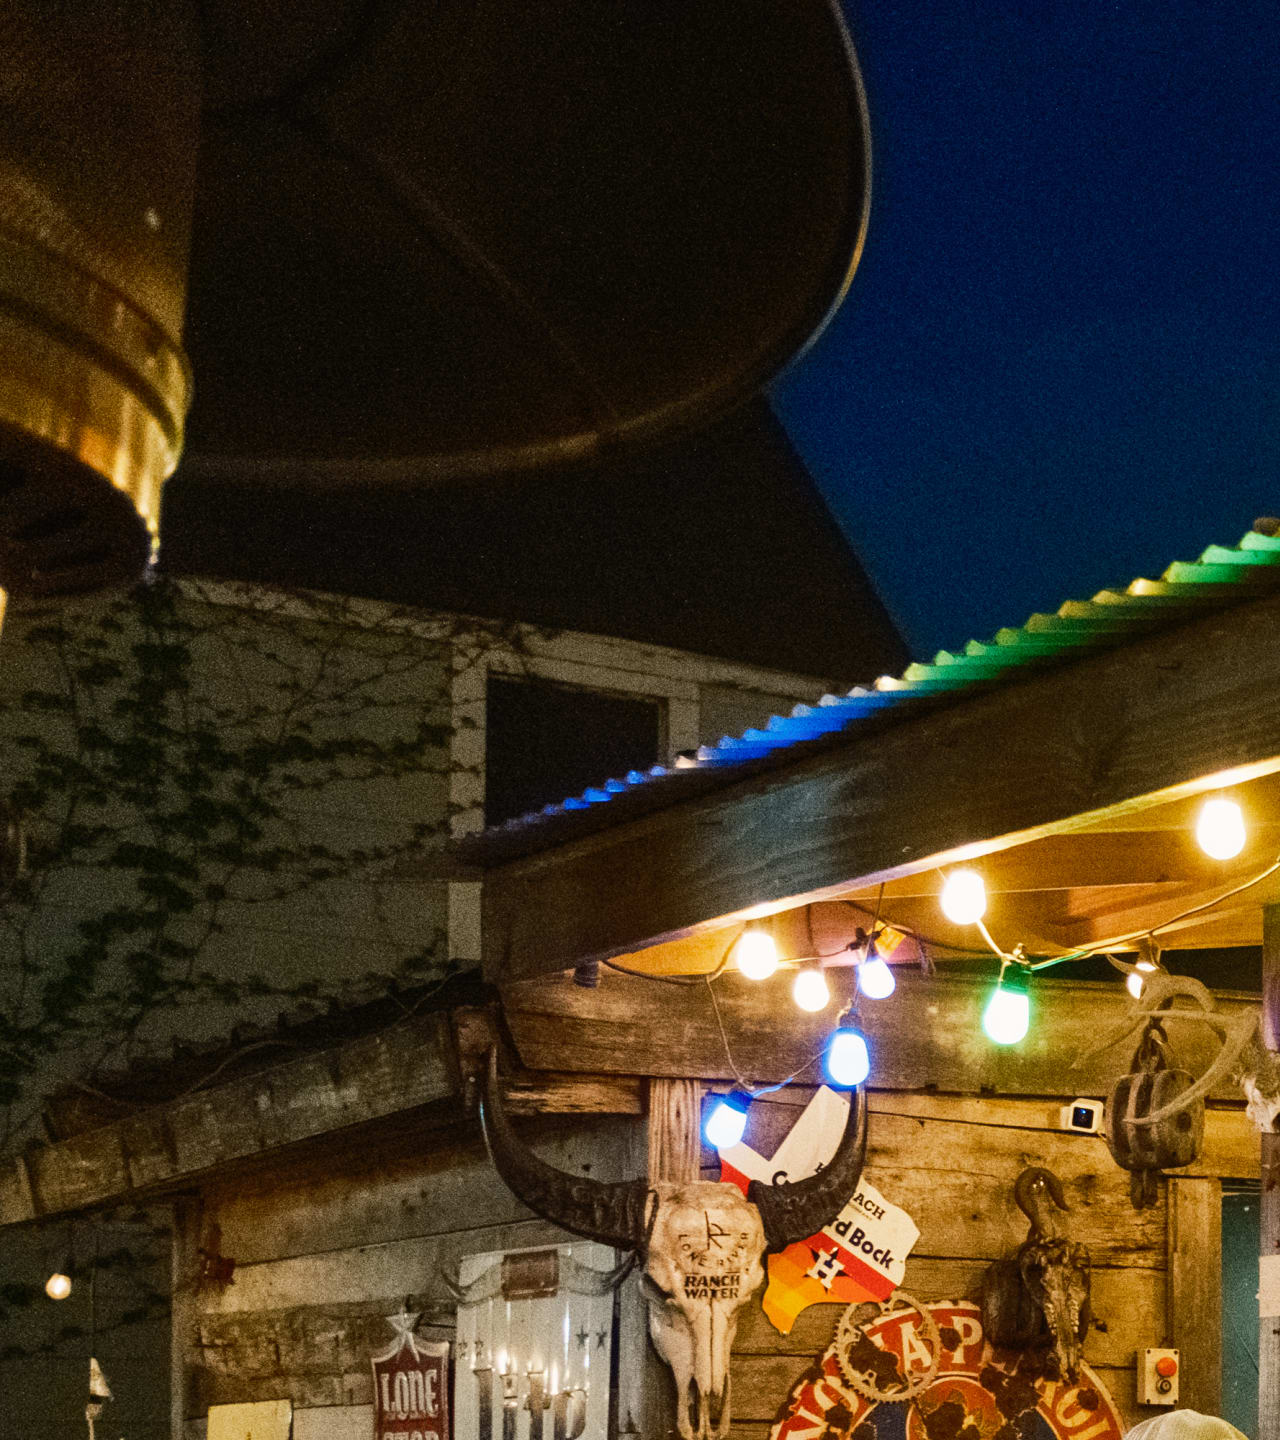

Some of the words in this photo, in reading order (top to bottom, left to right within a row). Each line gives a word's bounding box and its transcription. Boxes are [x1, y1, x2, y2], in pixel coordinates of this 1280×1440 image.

[848, 1226, 894, 1270] Bock
[684, 1274, 741, 1288] RANCH
[684, 1287, 740, 1300] WATER
[380, 1368, 439, 1418] LONE
